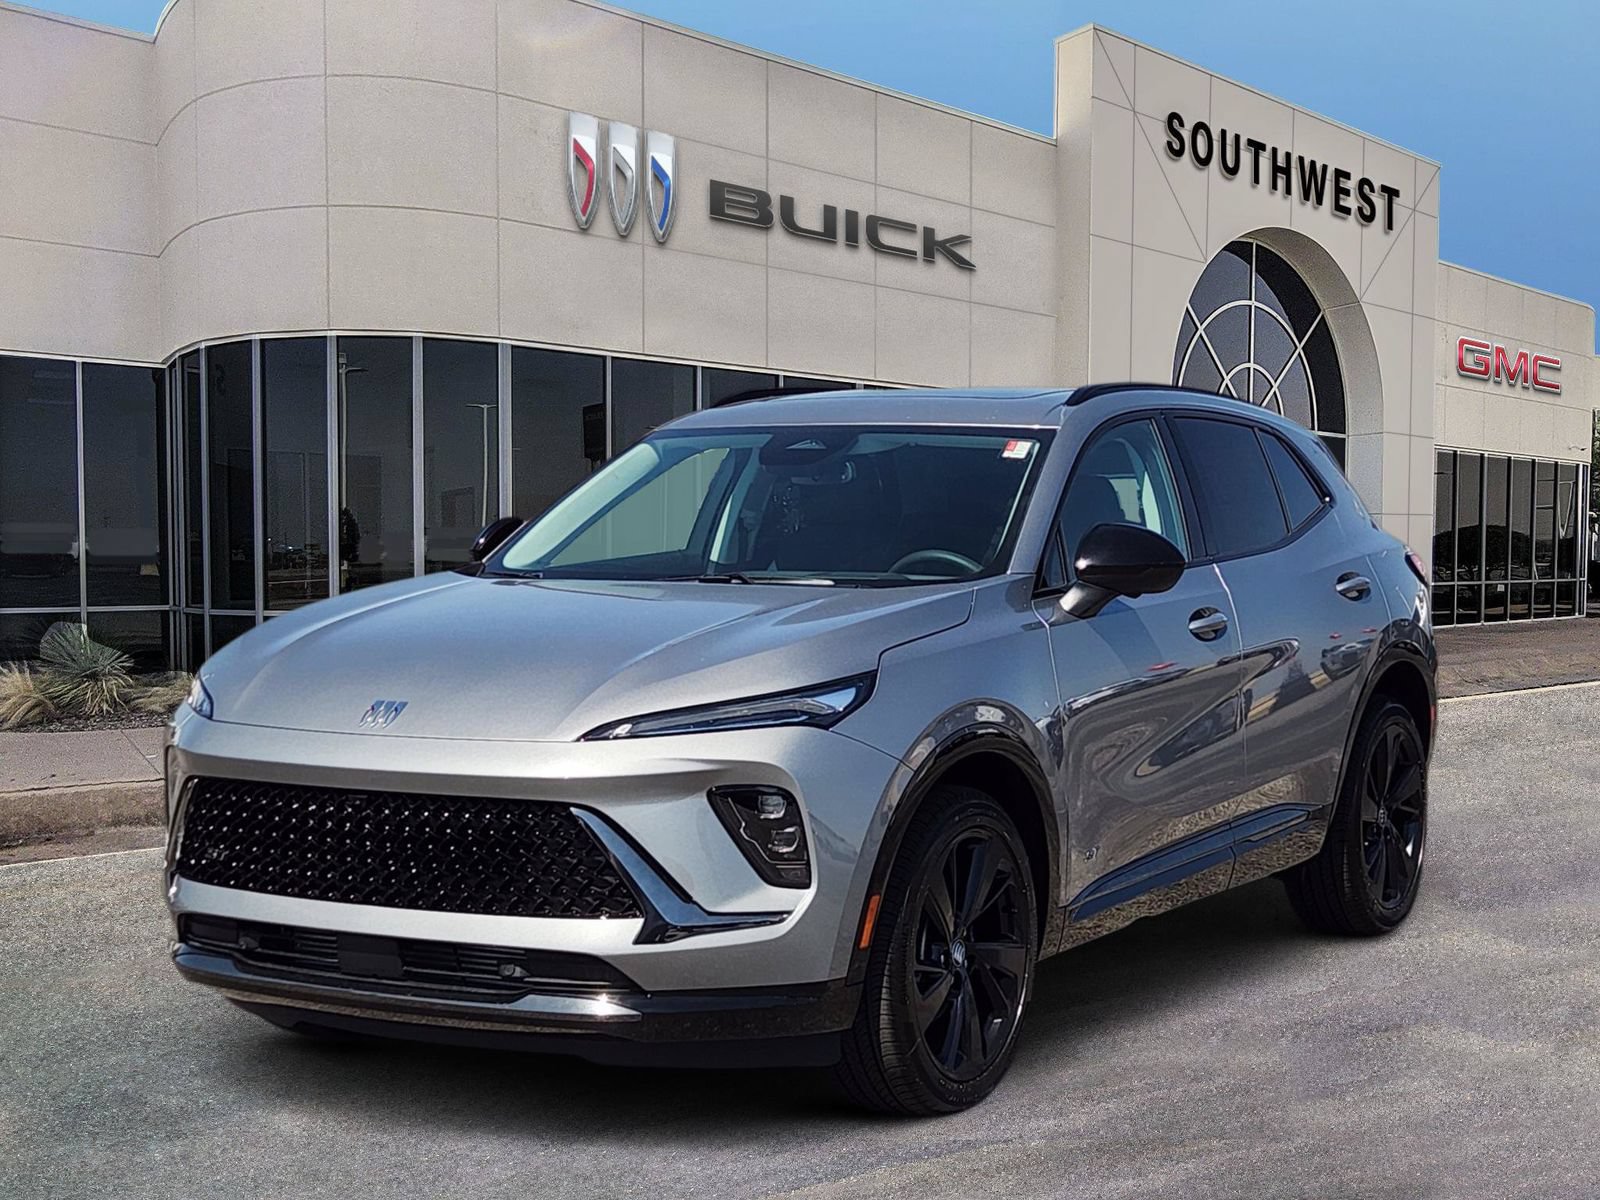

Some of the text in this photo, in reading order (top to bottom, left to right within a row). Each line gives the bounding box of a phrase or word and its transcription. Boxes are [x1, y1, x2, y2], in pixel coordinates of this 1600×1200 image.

[1165, 111, 1400, 231] SOUTHWEST
[709, 179, 976, 270] BUICK
[1457, 336, 1561, 394] GMC
